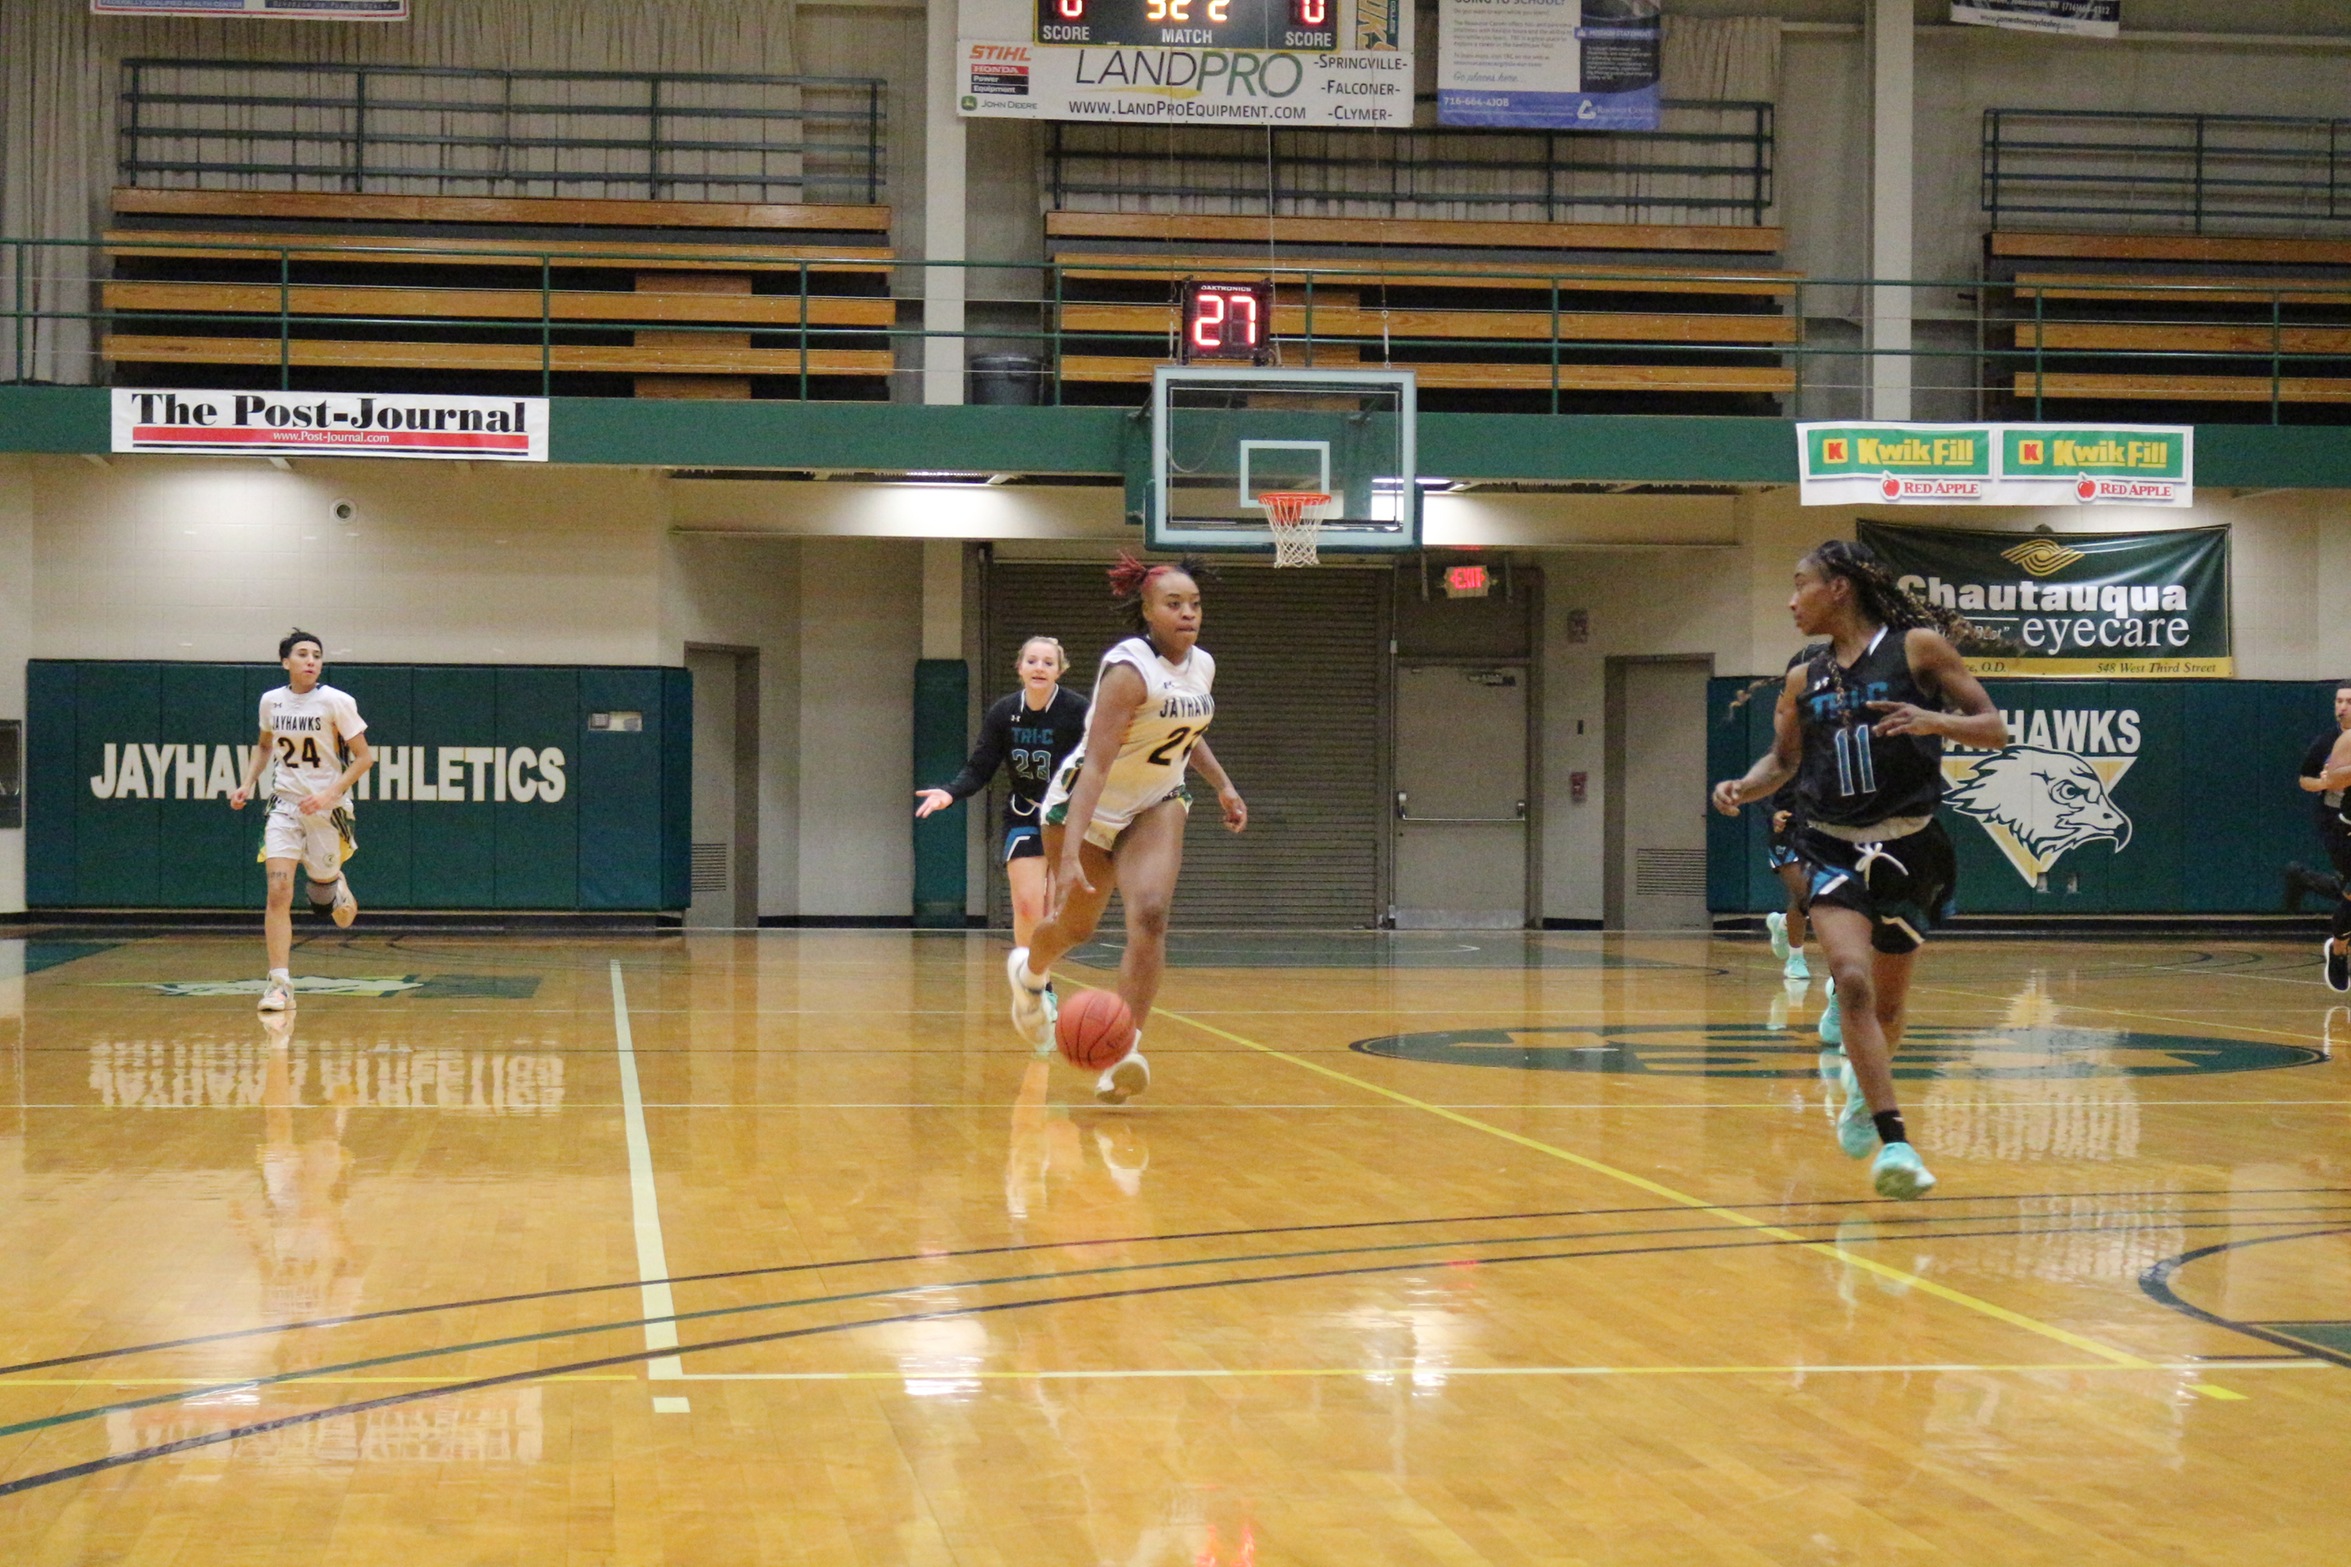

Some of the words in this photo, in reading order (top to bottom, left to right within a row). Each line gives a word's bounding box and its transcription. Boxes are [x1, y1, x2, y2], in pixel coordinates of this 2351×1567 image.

[1043, 26, 1090, 41] SCORE
[1162, 29, 1213, 44] MATCH
[1285, 32, 1332, 47] SCORE
[969, 44, 1031, 62] STIHL
[973, 75, 1000, 83] Power
[974, 66, 1019, 74] HONDA
[1075, 49, 1304, 98] LANDPRO
[973, 85, 1016, 94] Equipment
[1194, 294, 1256, 346] 27
[132, 393, 218, 427] The
[232, 394, 528, 433] Post-Journal
[273, 431, 390, 444] www.Post-Journal.com
[1828, 442, 1845, 460] K
[2024, 443, 2040, 462] K
[1904, 482, 1933, 495] RED
[1935, 481, 1980, 495] APPLE
[2100, 483, 2128, 496] RED
[2129, 484, 2172, 498] APPLE
[2022, 617, 2190, 656] eyecare
[2096, 662, 2117, 674] 548
[2120, 662, 2145, 674] West
[2149, 662, 2181, 674] Third
[2183, 662, 2217, 674] Street
[278, 736, 321, 770] 24
[1835, 723, 1878, 797] 11
[345, 744, 566, 803] THLETICS
[1011, 747, 1051, 782] 23
